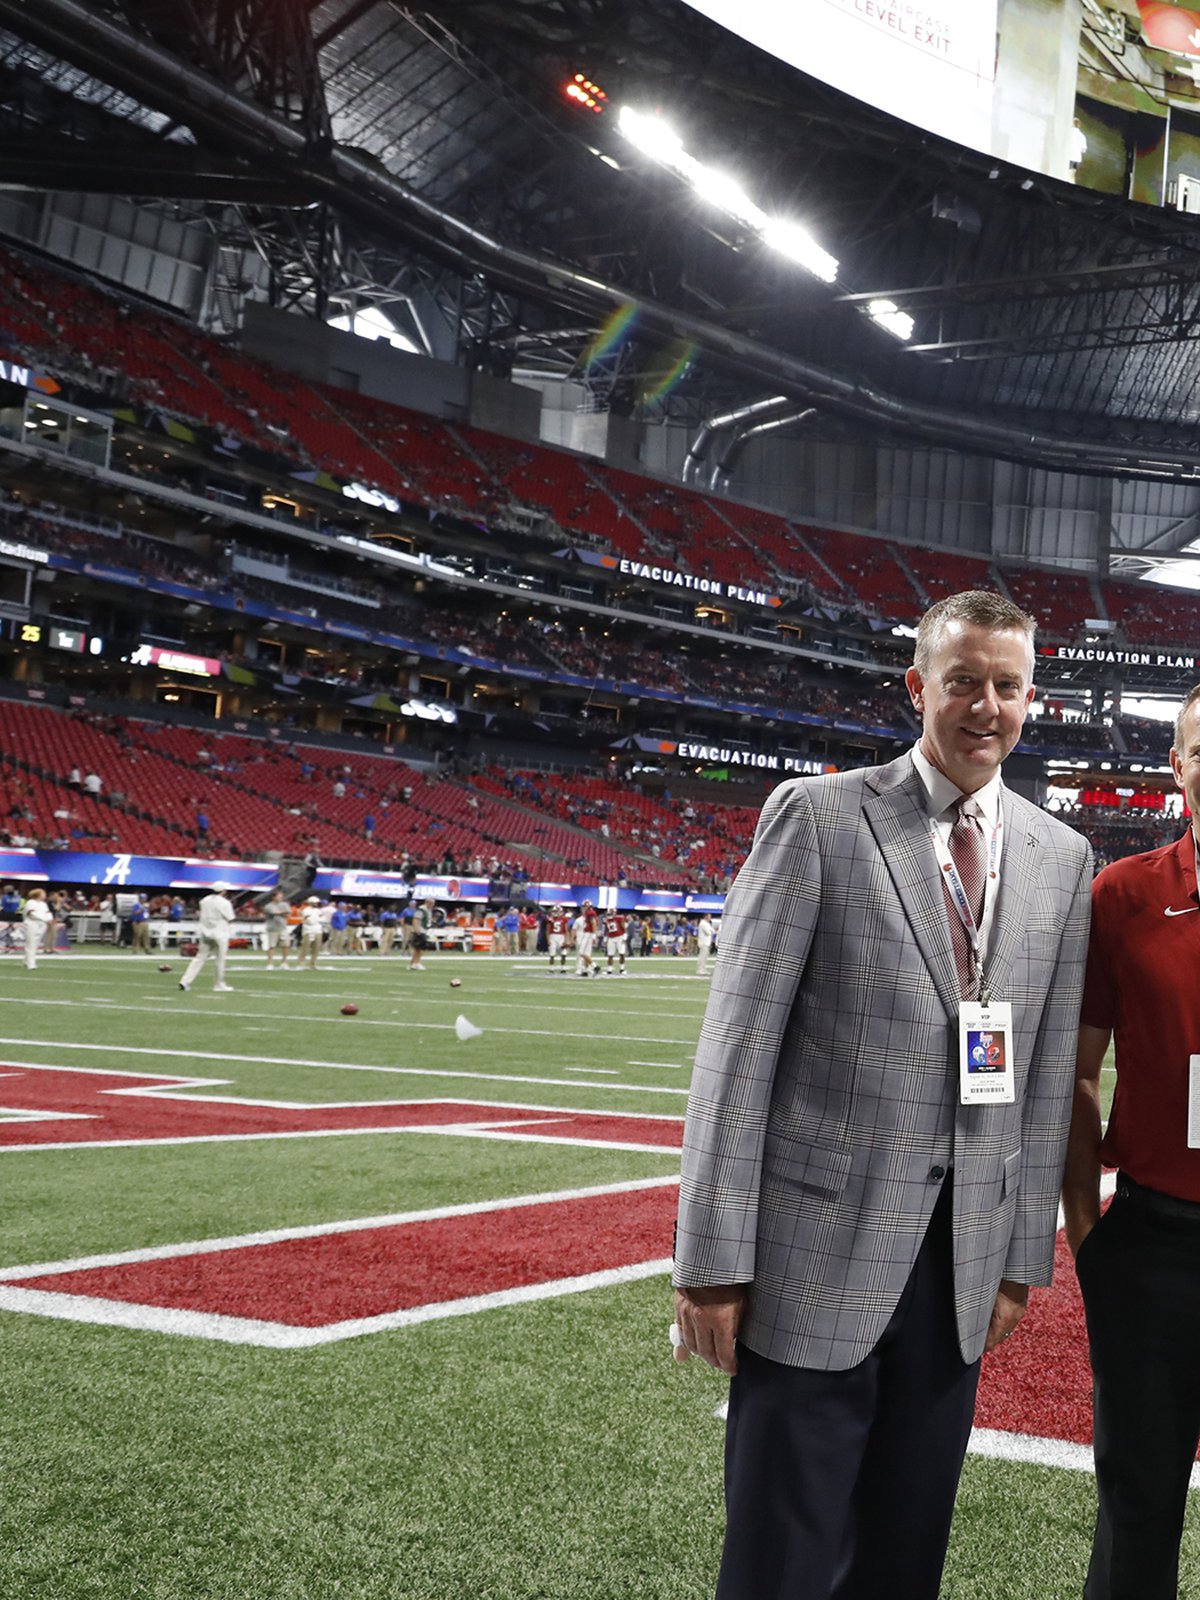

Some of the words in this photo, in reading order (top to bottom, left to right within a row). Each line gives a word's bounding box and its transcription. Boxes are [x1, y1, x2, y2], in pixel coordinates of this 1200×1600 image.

[855, 0, 907, 34] LEVEL
[914, 25, 951, 53] EXIT
[0, 539, 49, 563] tadium
[620, 559, 720, 594] EVACUATION
[727, 585, 766, 606] PLAN
[1058, 647, 1151, 665] EVACUATION
[1157, 655, 1195, 668] PLAN
[678, 743, 778, 769] EVACUATION
[785, 758, 823, 775] PLAN
